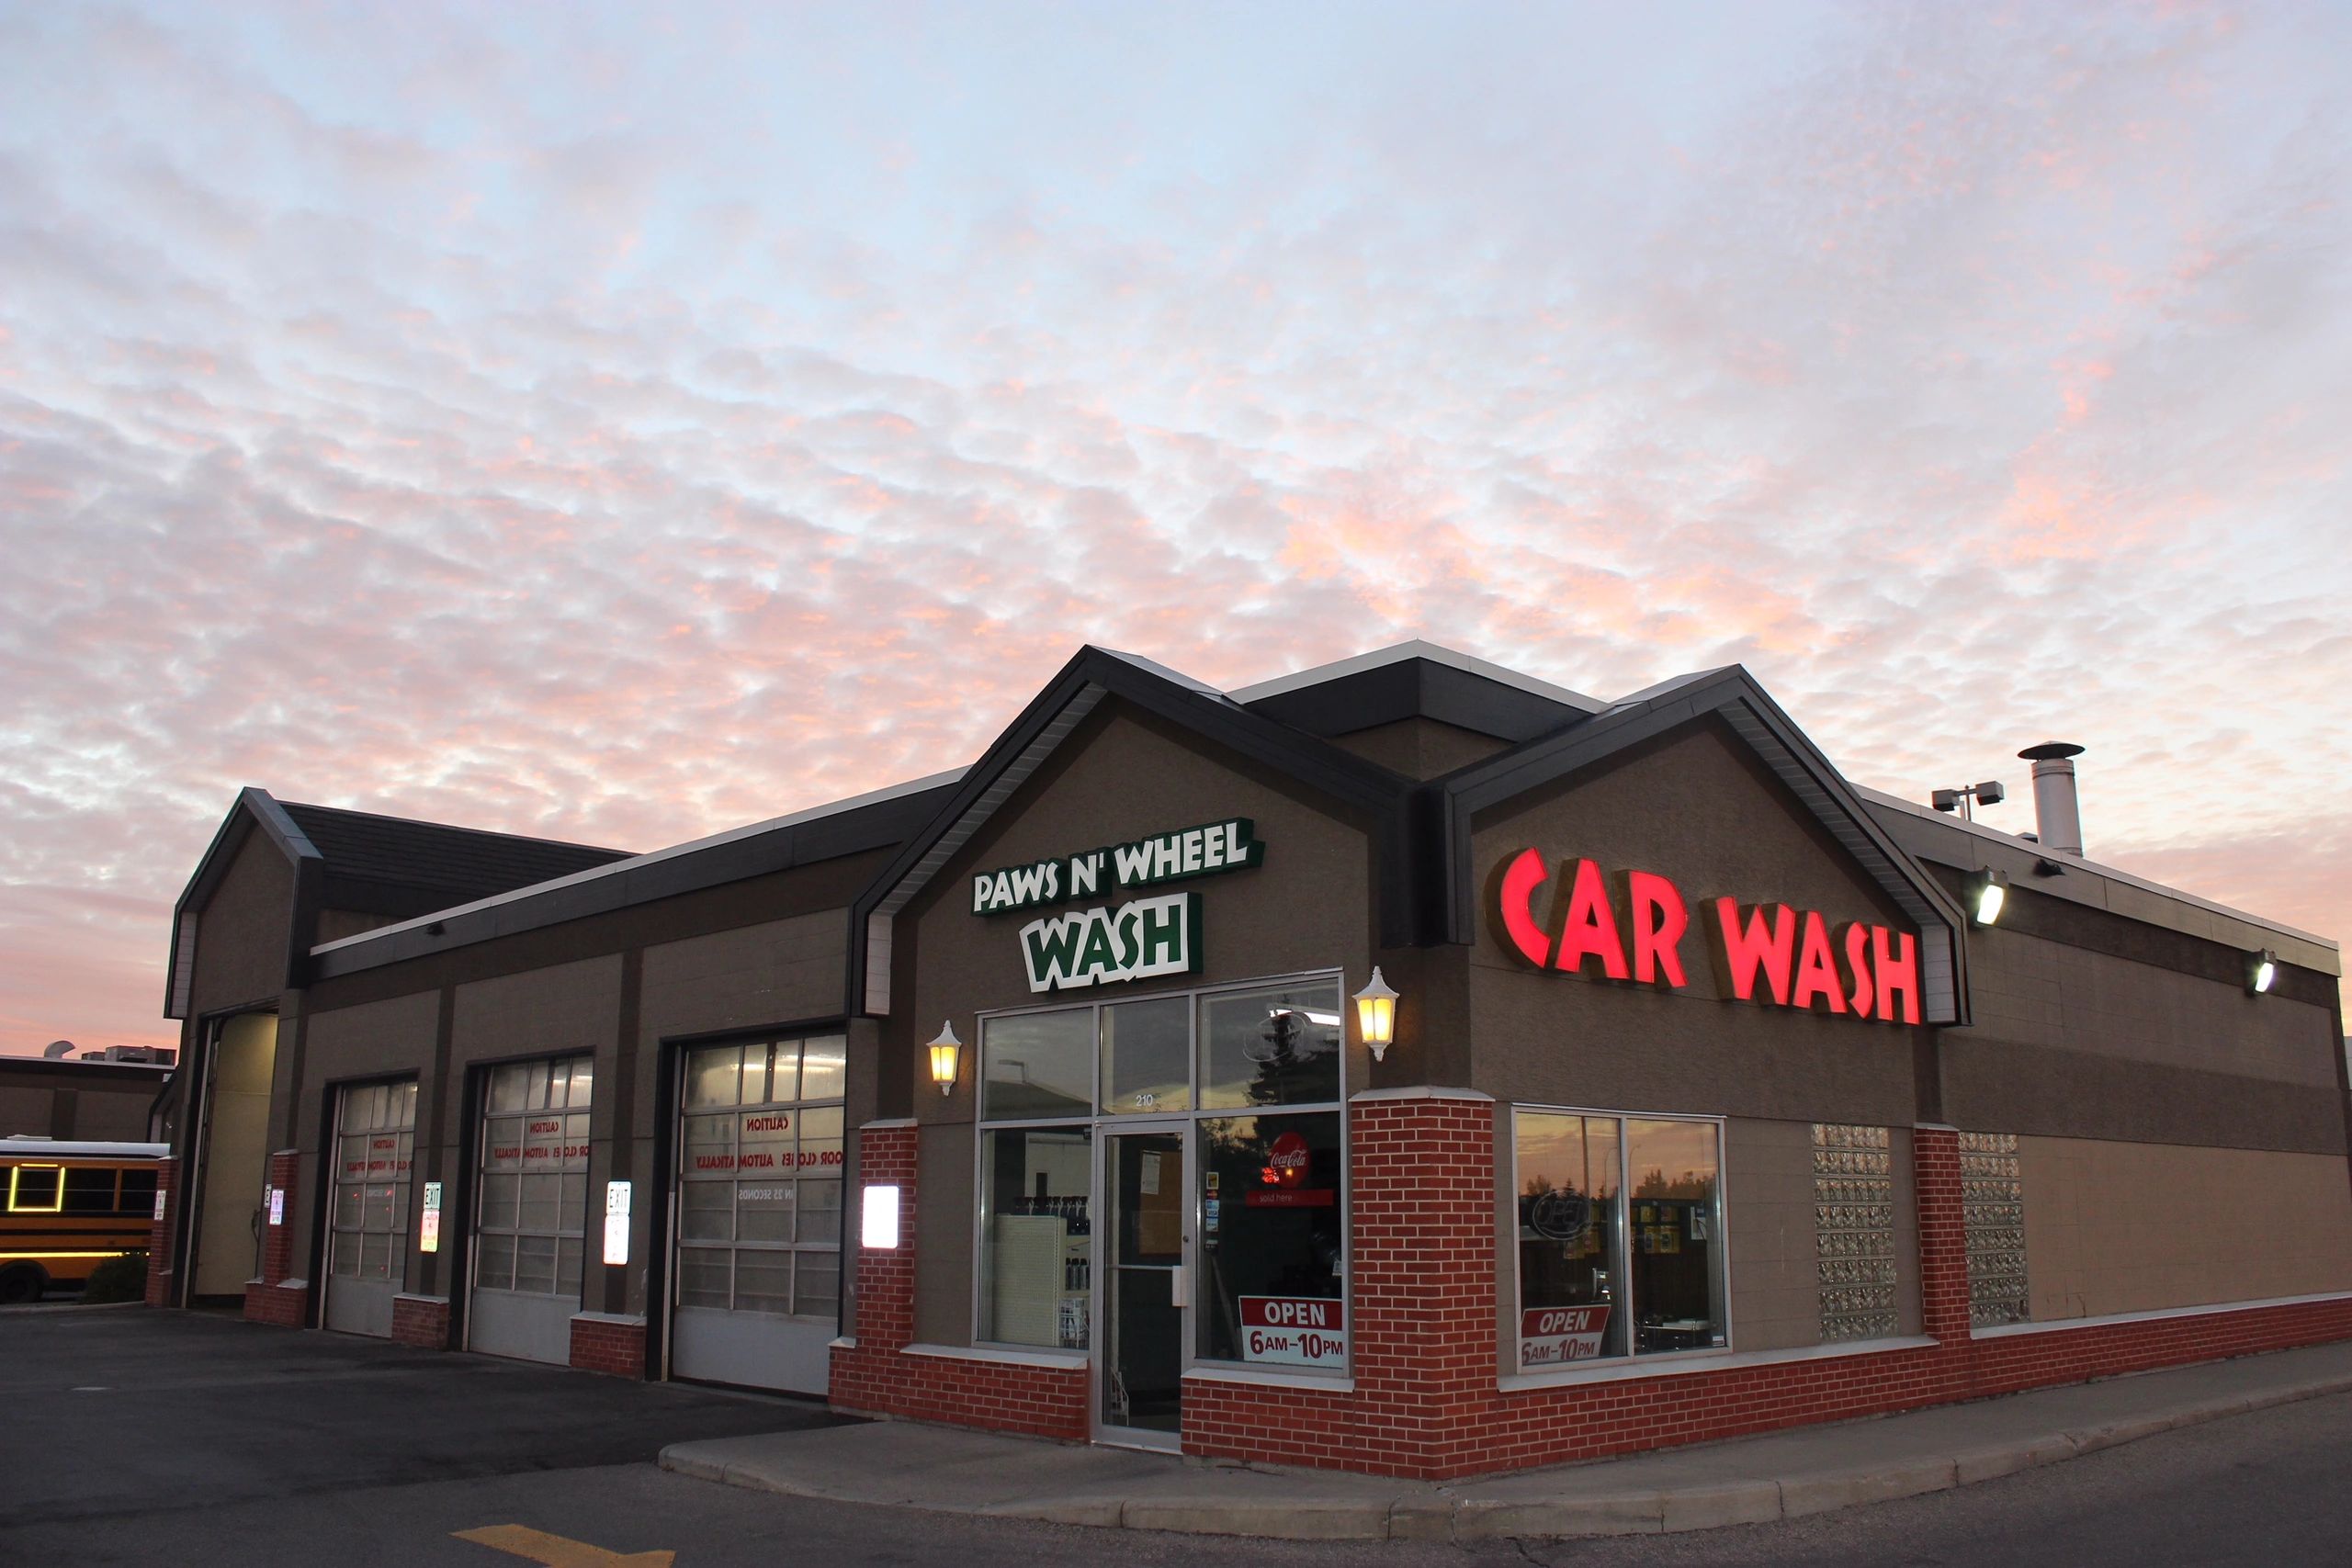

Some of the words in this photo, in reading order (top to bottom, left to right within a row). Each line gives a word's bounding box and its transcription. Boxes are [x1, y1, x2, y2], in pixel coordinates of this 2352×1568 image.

[974, 861, 1058, 912] PAWS
[1070, 852, 1104, 896] N'
[1114, 822, 1249, 885] WHEEL
[1024, 903, 1182, 984] WASH
[1500, 846, 1688, 988] CAR
[1715, 896, 1920, 1025] WASH
[1136, 1094, 1153, 1107] 210
[425, 1188, 439, 1205] EXIT
[609, 1188, 628, 1208] EXIT
[1259, 1193, 1274, 1203] sold
[1275, 1193, 1293, 1202] here
[1264, 1302, 1326, 1326] OPEN
[1539, 1311, 1591, 1334] OPEN
